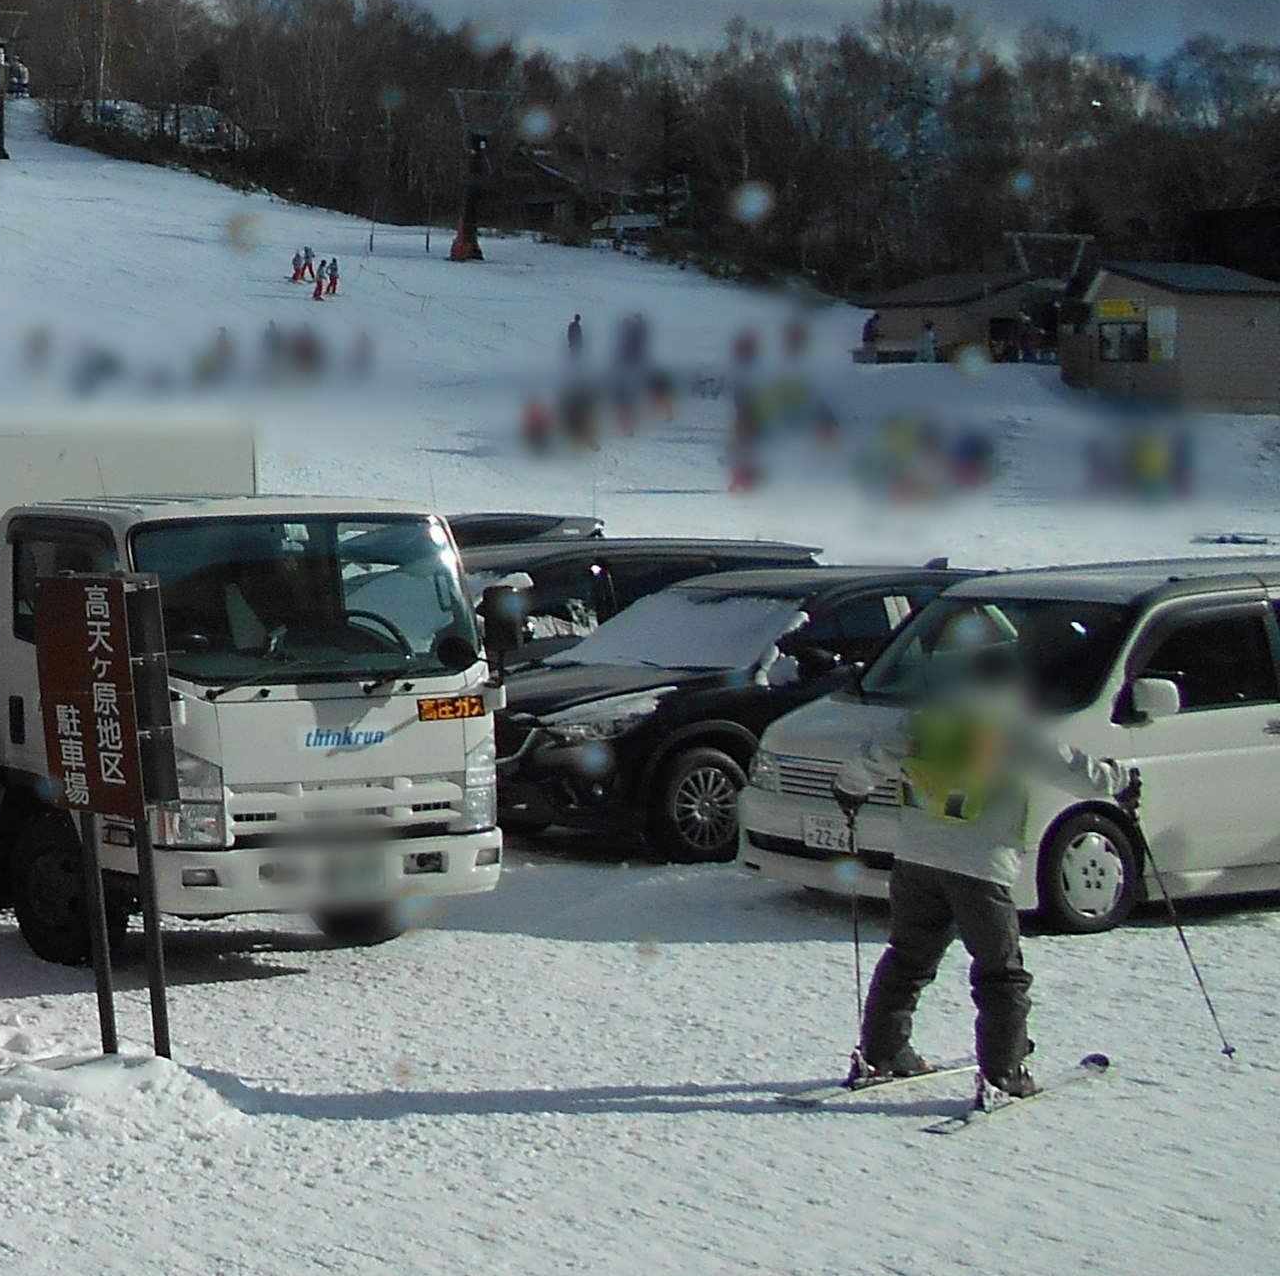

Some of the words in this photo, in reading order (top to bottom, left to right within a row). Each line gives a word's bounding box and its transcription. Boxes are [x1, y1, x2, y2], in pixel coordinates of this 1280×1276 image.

[84, 584, 127, 785] 高天ヶ原地区
[420, 698, 484, 720] 高圧ガス
[56, 704, 90, 806] 駐車場
[305, 726, 386, 748] thinkrun
